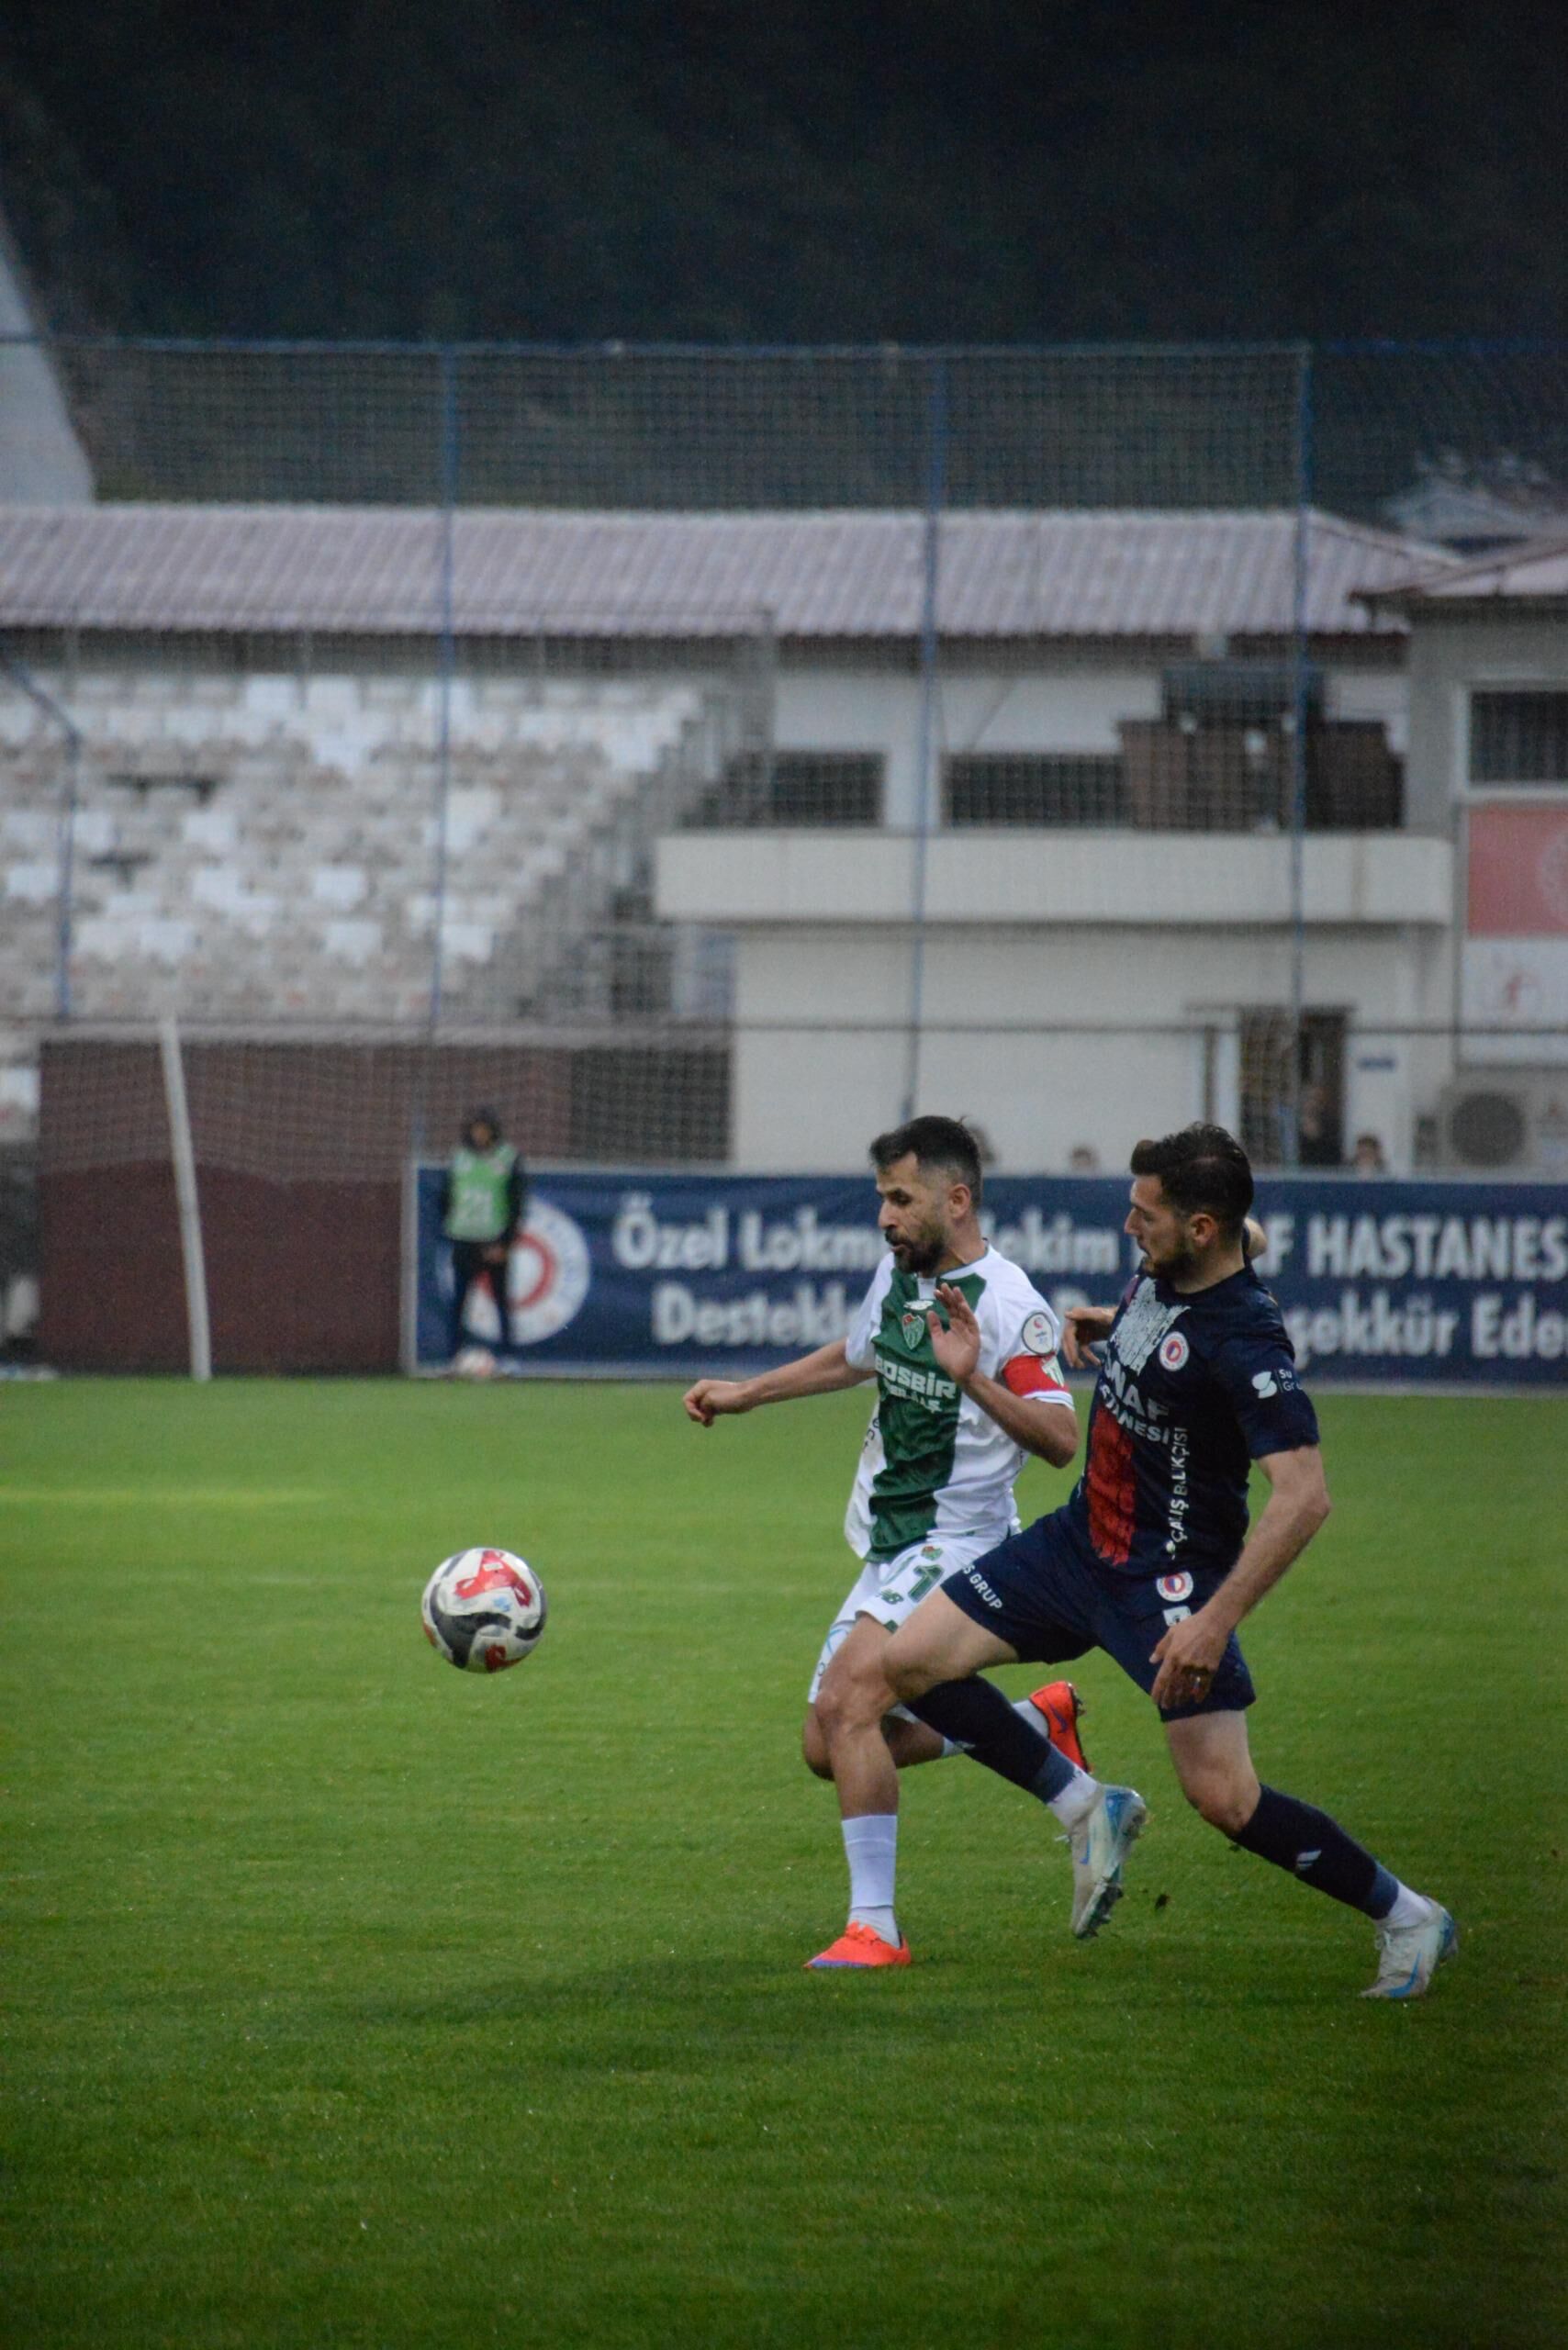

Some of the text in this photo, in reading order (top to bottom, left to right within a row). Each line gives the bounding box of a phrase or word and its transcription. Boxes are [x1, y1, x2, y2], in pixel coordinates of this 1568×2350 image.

[613, 1192, 728, 1270] Özel
[739, 1204, 894, 1271] Lokm
[1306, 1214, 1568, 1281] HASTANES
[1282, 1288, 1460, 1368] şekkür
[1472, 1291, 1568, 1359] Ede
[969, 1573, 1003, 1609] GRUP
